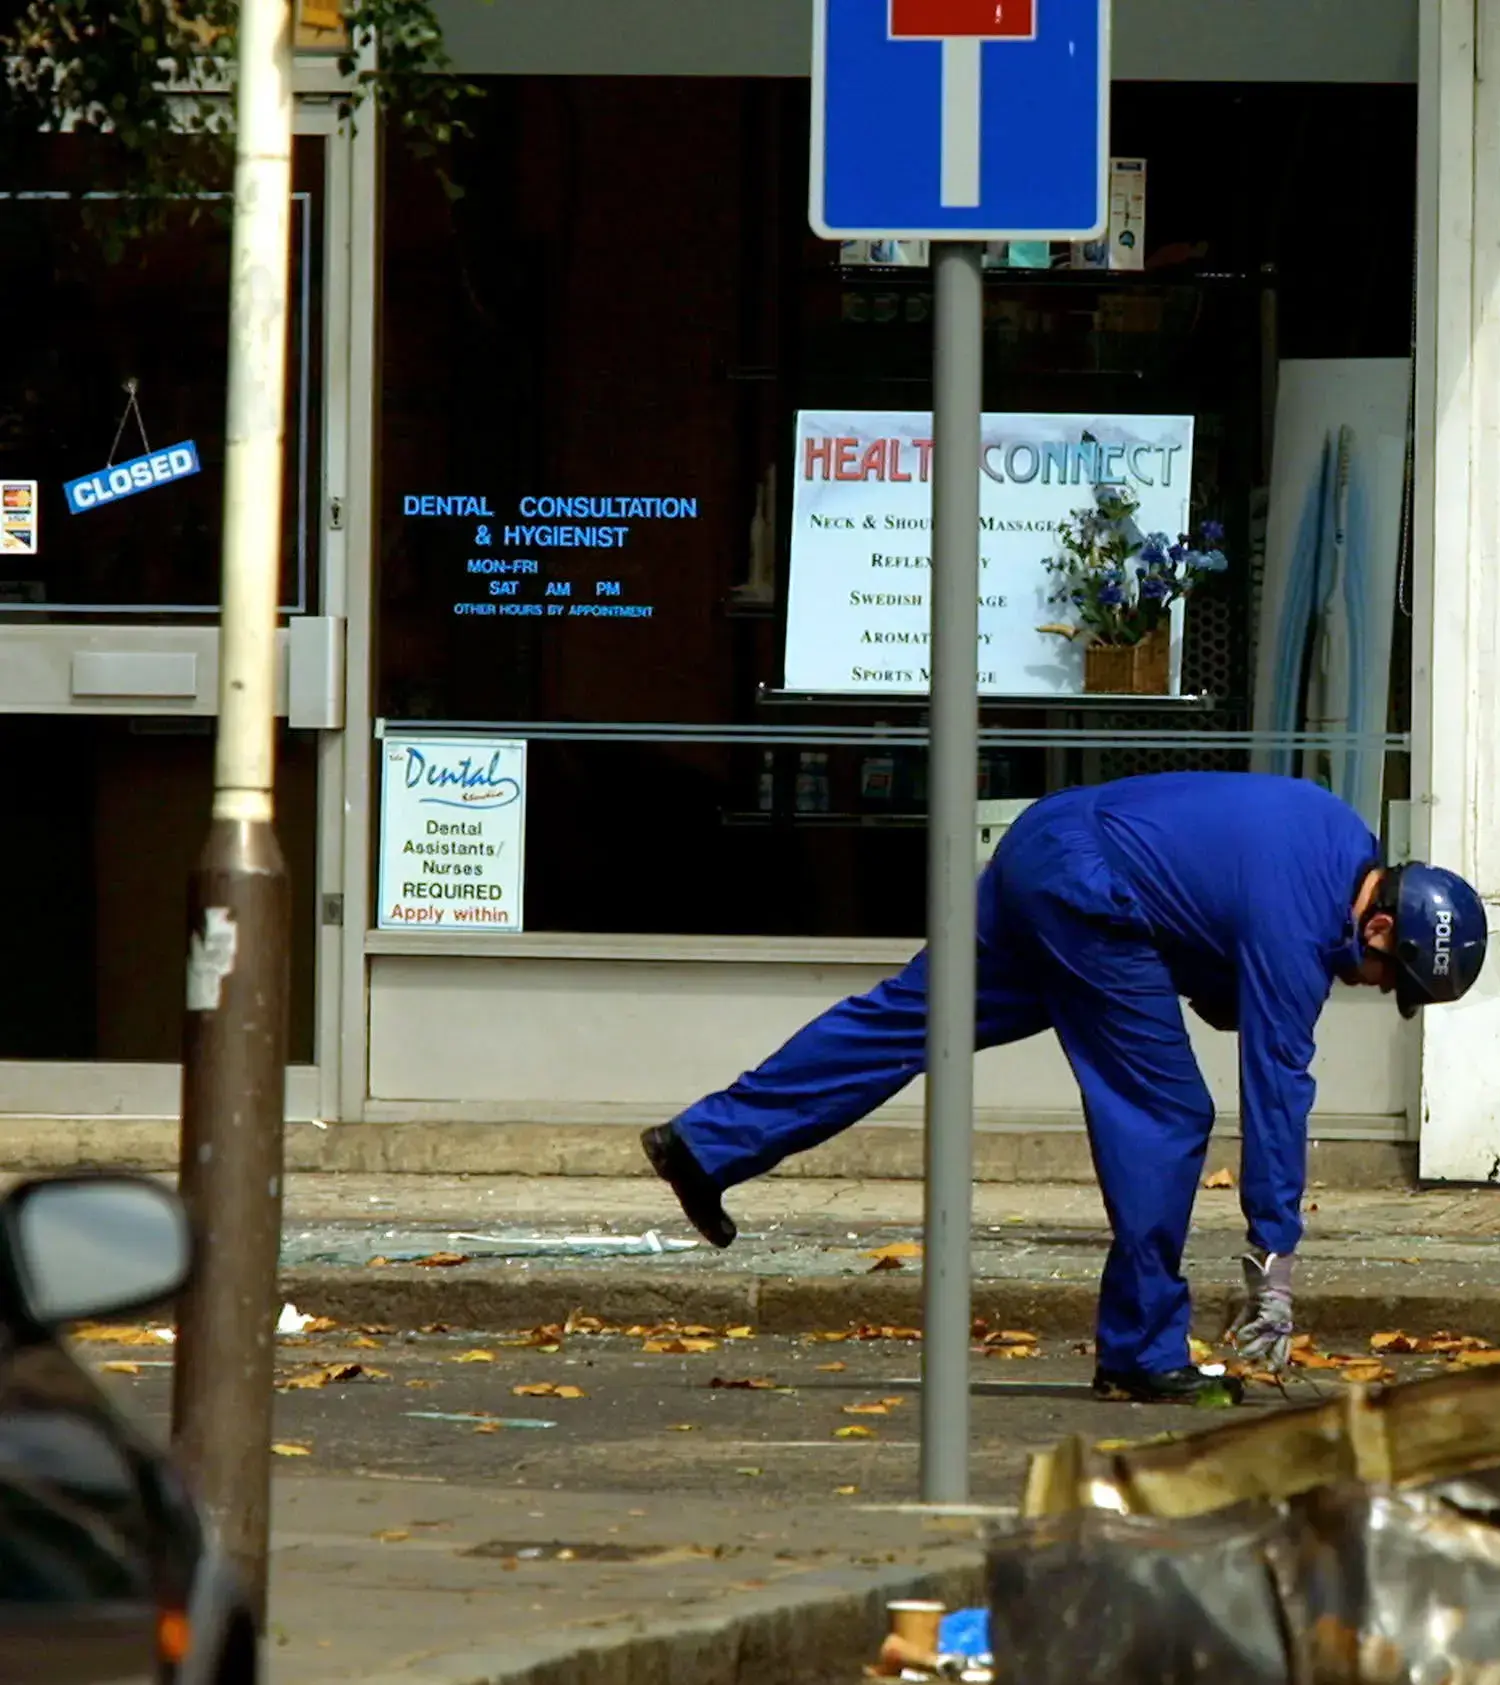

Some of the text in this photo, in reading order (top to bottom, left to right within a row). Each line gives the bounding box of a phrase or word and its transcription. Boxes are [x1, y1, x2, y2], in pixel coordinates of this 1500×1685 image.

[804, 437, 1182, 487] HEALT CONNECT
[72, 448, 193, 508] CLOSED
[404, 495, 697, 519] DENTAL CONSULTATION
[810, 514, 855, 530] NECK
[862, 514, 877, 530] &
[474, 524, 629, 548] & HYGIENIST
[467, 558, 539, 574] MON-FRI
[489, 581, 621, 596] SAT AM PM
[849, 590, 922, 607] SWEDISH
[453, 603, 655, 618] OTHER HOURS BY APPOINTMENT
[852, 666, 913, 683] SPORTS
[405, 747, 506, 790] Dental
[426, 820, 483, 836] Dental
[402, 839, 505, 858] Assistants/
[422, 860, 484, 877] Nurses
[402, 882, 503, 901] REQUIRED
[391, 904, 510, 924] Apply within
[1432, 910, 1453, 976] POLICE
